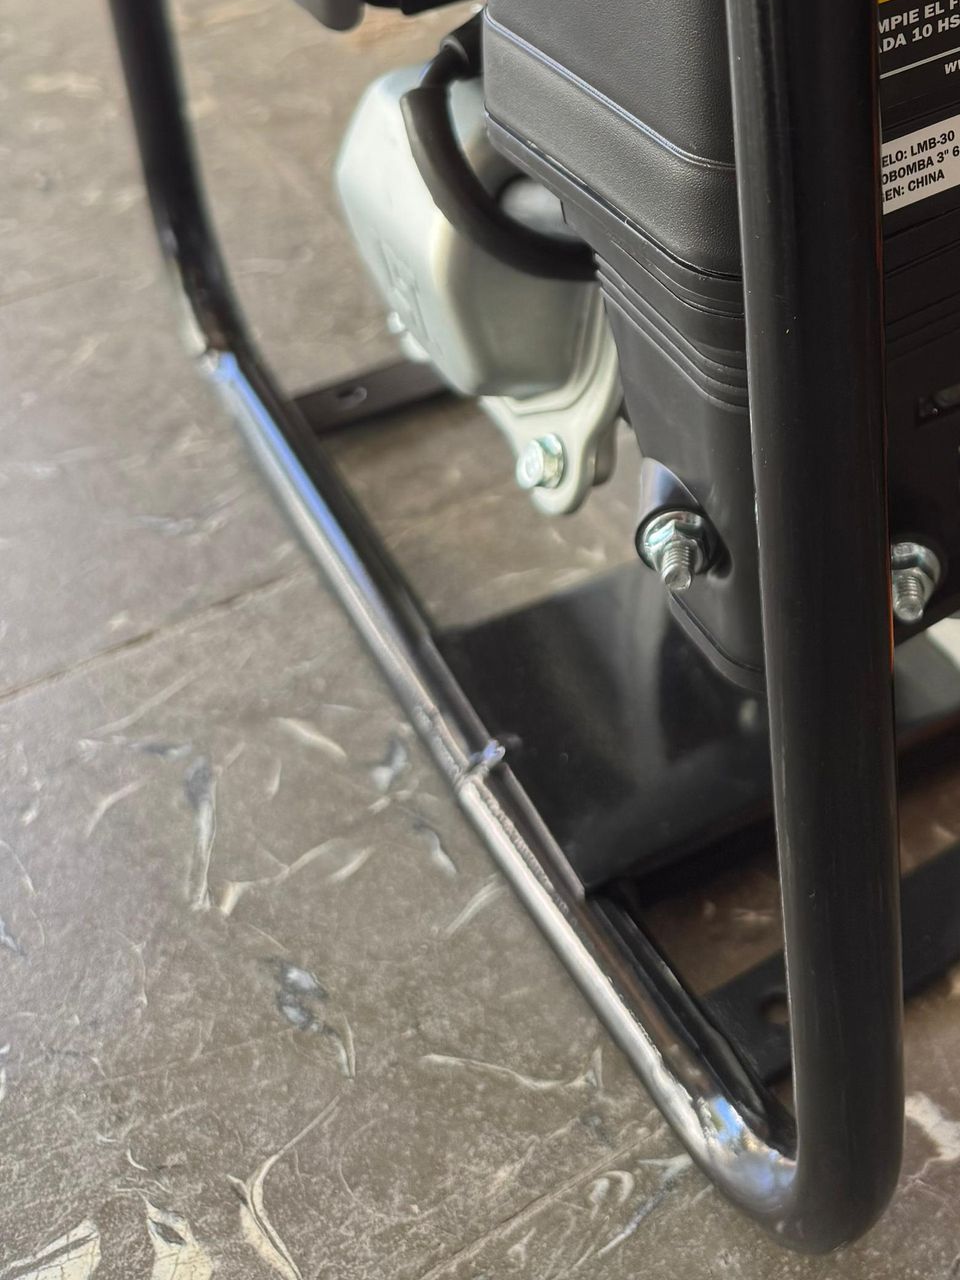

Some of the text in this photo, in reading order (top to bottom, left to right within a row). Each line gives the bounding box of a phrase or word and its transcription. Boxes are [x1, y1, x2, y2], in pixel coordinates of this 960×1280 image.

[924, 1, 945, 19] EL
[879, 32, 907, 53] DA
[912, 23, 933, 42] 10
[937, 14, 960, 33] HS
[910, 130, 955, 157] LMB-30
[936, 149, 949, 164] 3"
[881, 169, 945, 202] EN: CHINA
